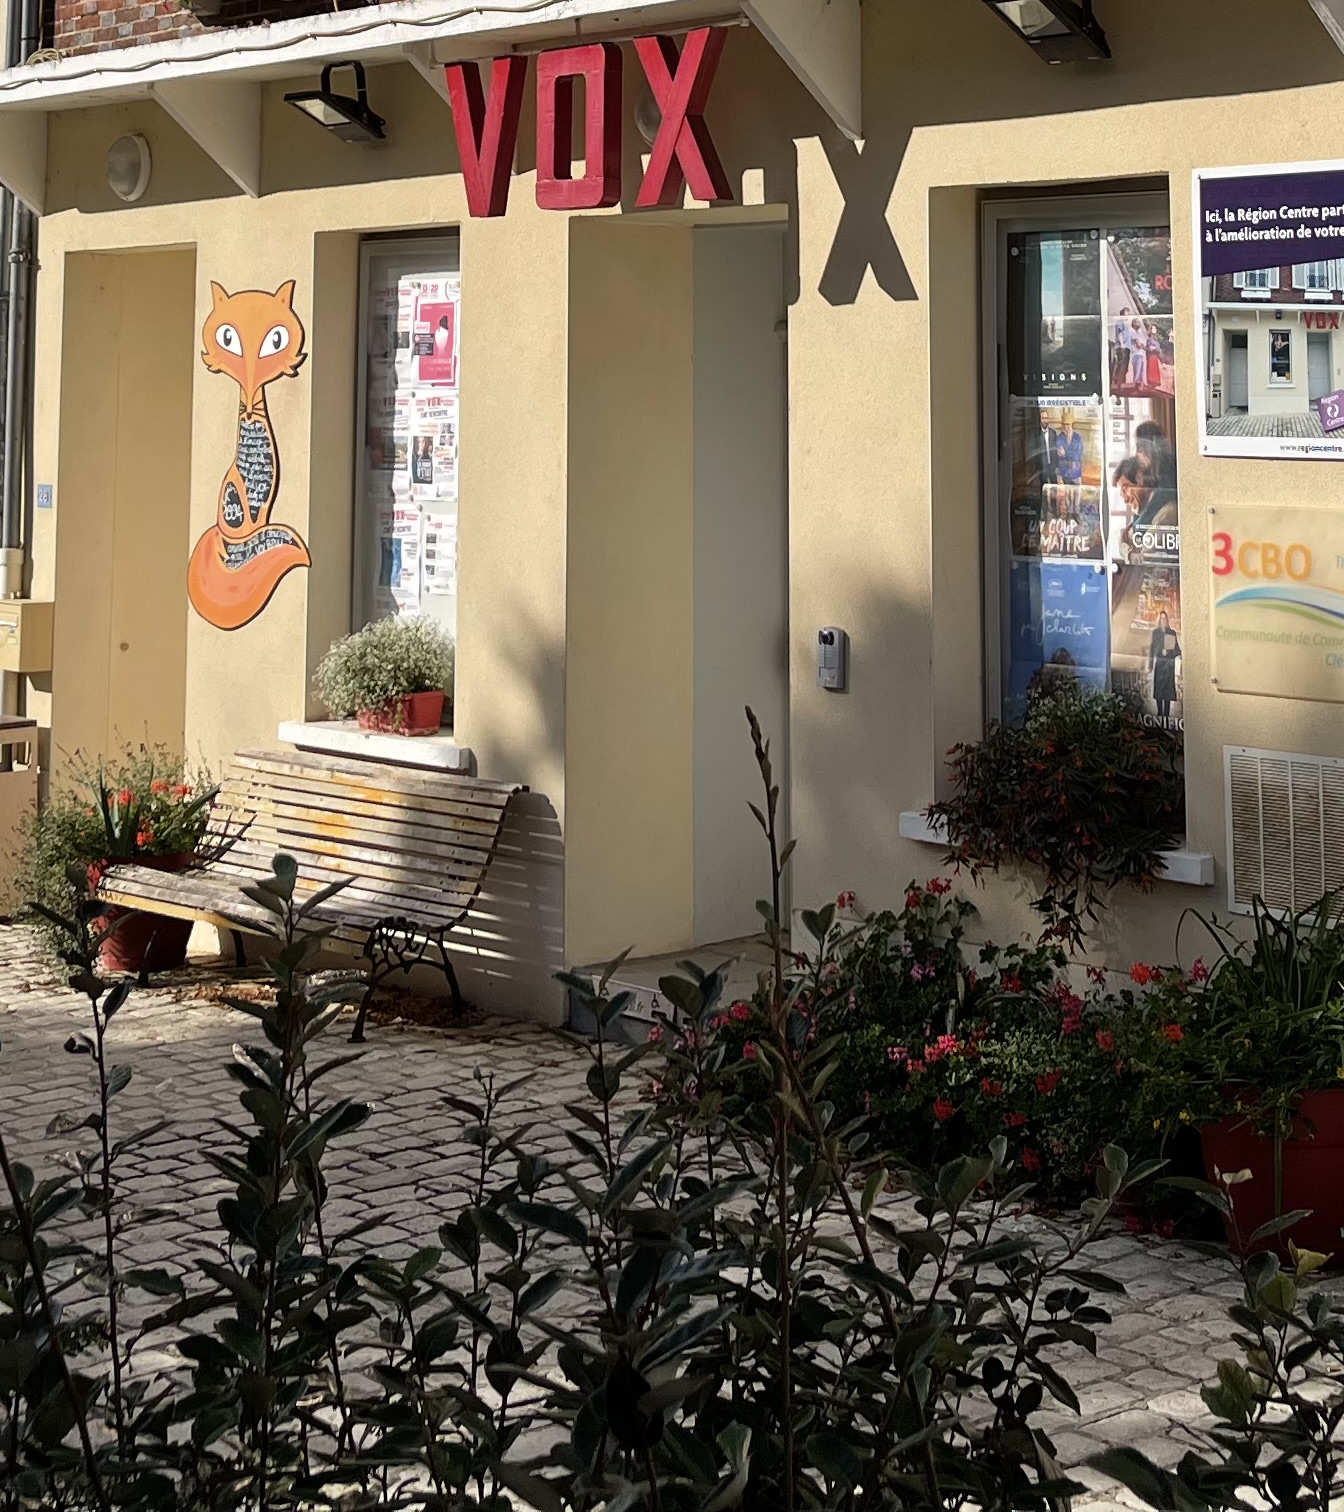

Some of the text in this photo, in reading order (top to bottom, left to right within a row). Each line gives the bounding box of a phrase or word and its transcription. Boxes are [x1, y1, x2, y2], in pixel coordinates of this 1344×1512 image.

[444, 26, 734, 218] VOX
[1205, 208, 1222, 223] Ici,
[1224, 208, 1235, 222] la
[1238, 206, 1277, 224] Région
[1279, 205, 1319, 220] Centre
[1205, 229, 1213, 242] à
[1215, 226, 1294, 242] l'amélioration
[1296, 223, 1312, 238] de
[1304, 312, 1339, 329] VOX
[1023, 373, 1086, 381] VISIONS
[1049, 519, 1078, 534] COUP
[1211, 532, 1312, 581] 3CBO
